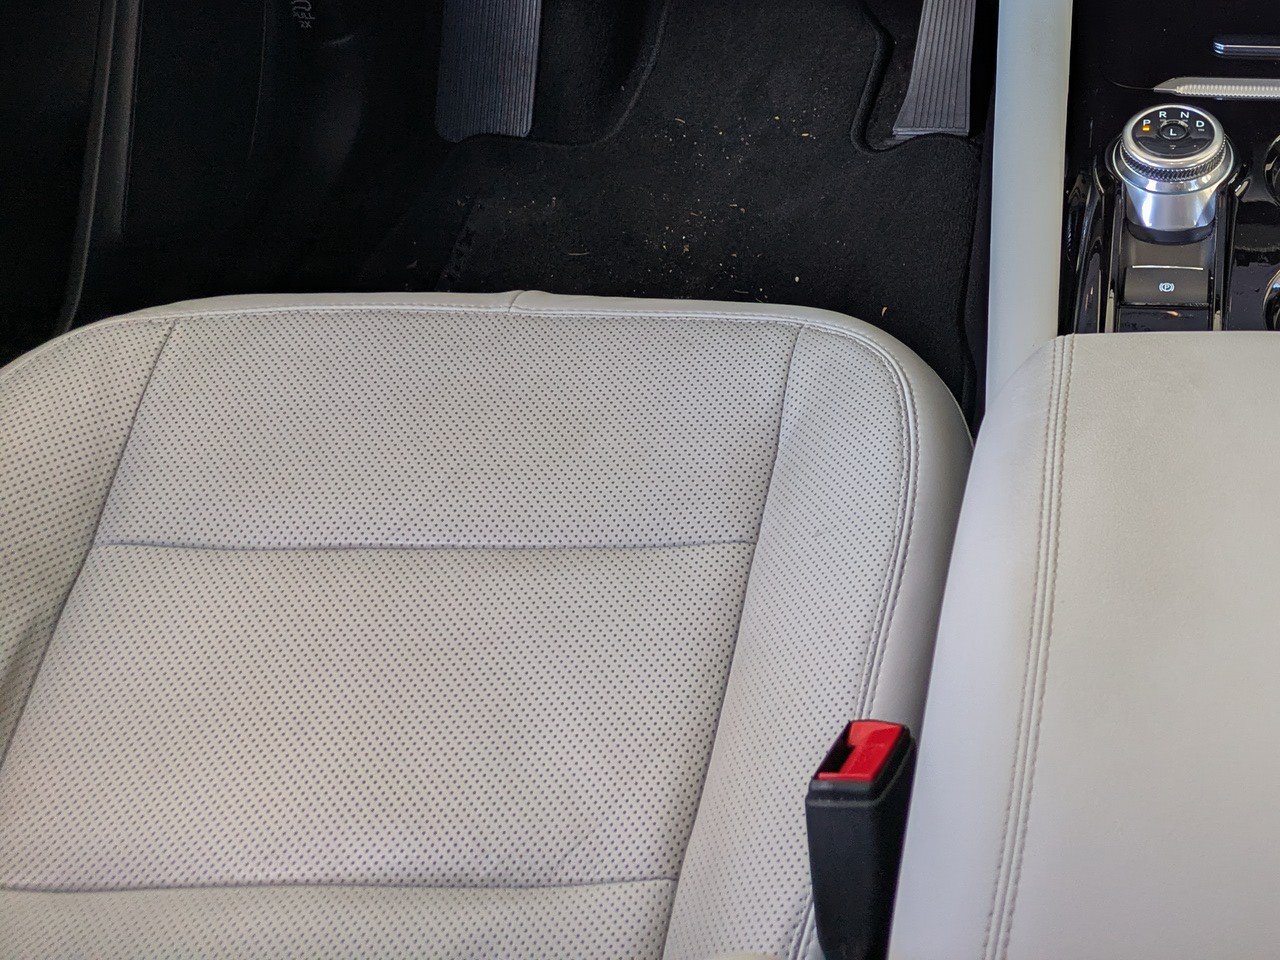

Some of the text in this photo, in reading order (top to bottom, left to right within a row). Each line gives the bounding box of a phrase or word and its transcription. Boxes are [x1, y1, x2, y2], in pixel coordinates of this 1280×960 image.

[1180, 111, 1190, 119] N
[1196, 120, 1205, 128] D
[1169, 128, 1177, 136] L
